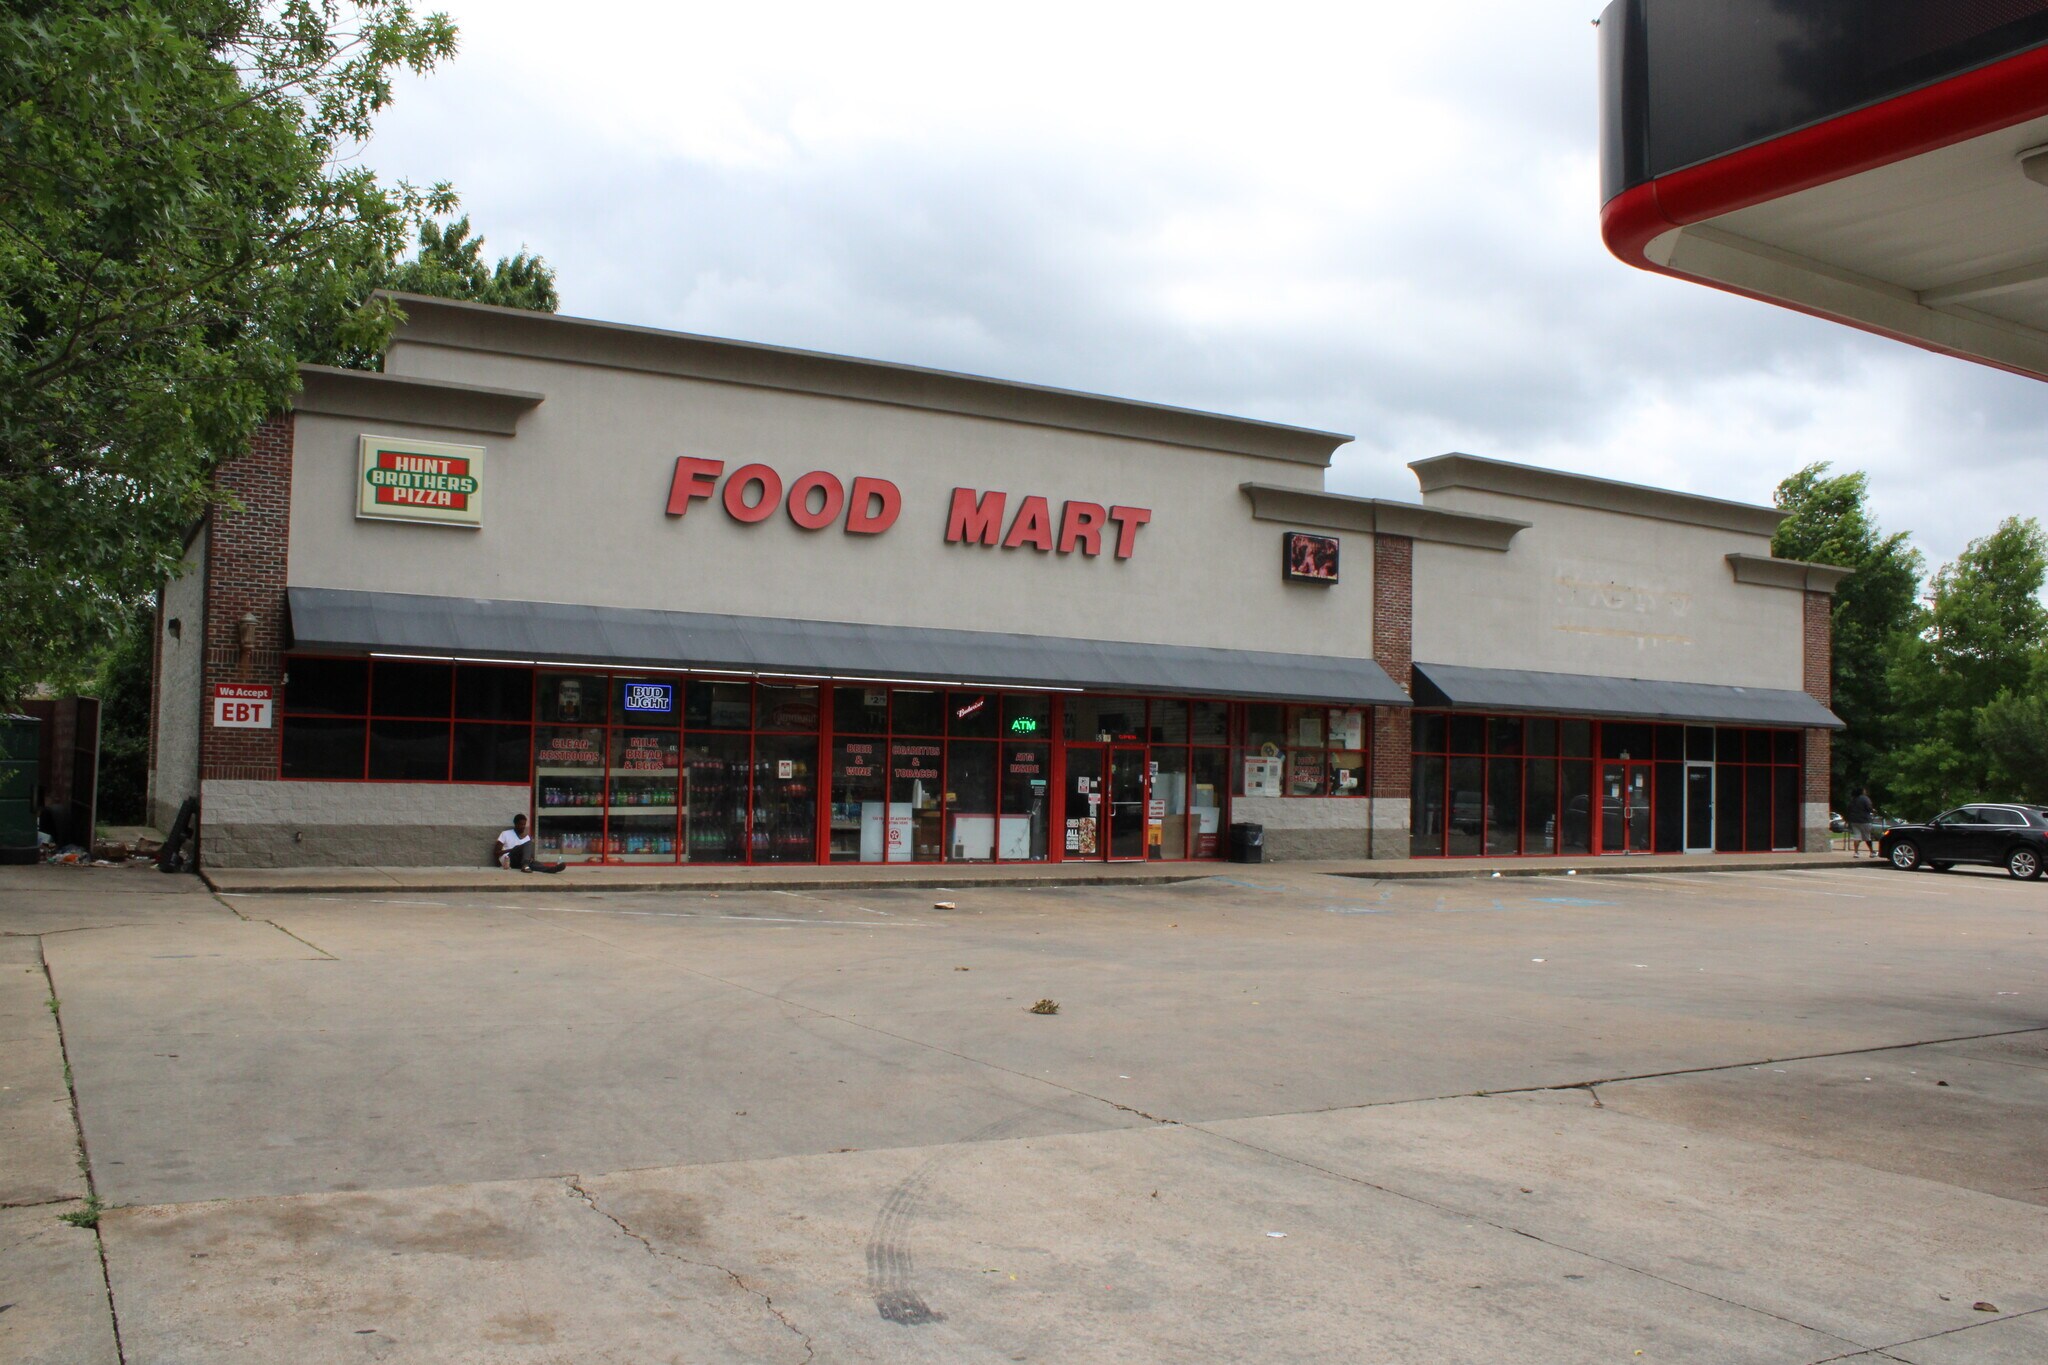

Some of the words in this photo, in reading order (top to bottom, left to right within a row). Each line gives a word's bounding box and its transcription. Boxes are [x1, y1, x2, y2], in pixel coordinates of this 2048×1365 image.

[395, 456, 452, 475] HUNT
[372, 470, 473, 492] BROTHERS
[393, 487, 451, 505] PIZZA
[665, 456, 902, 535] FOOD
[944, 487, 1152, 559] MART
[219, 687, 235, 696] We
[235, 688, 268, 698] Accept
[633, 686, 663, 698] BUD
[627, 696, 669, 709] LIGHT
[222, 702, 264, 722] EBT
[1011, 719, 1036, 731] ATM
[552, 738, 589, 749] CLEAN
[630, 737, 659, 748] MILK
[846, 743, 873, 754] BEER
[892, 745, 940, 756] CIGARETTES
[540, 750, 600, 761] RESTROOMS
[625, 749, 663, 760] BREAD
[854, 755, 864, 765] &
[635, 761, 664, 771] EGGS
[912, 757, 920, 767] &
[845, 766, 872, 776] WINE
[894, 768, 938, 779] TOBACCO
[1066, 829, 1079, 837] ALL
